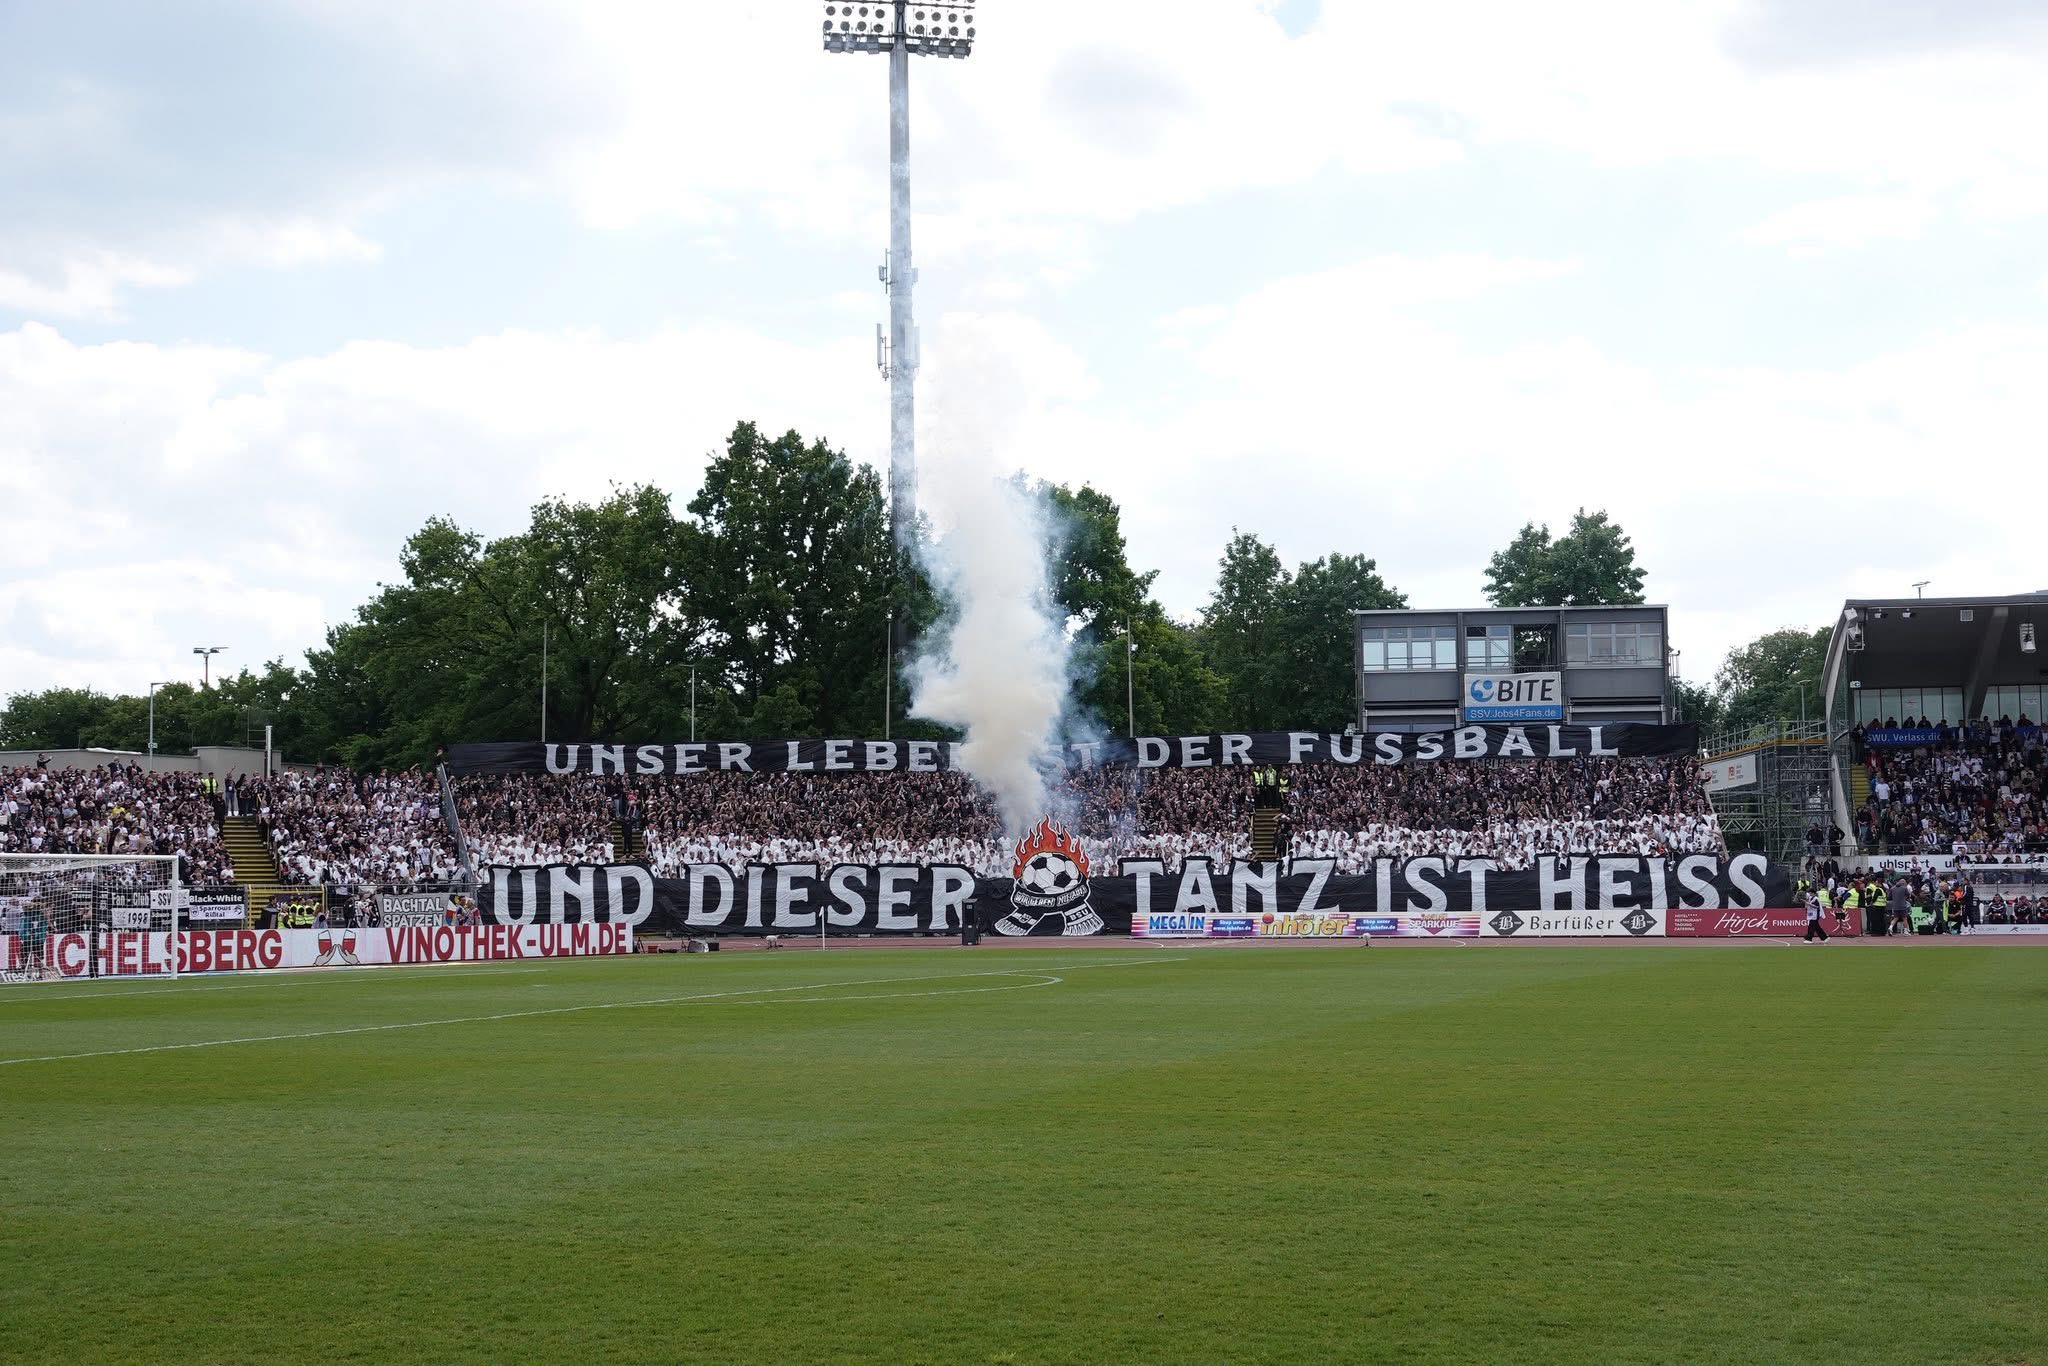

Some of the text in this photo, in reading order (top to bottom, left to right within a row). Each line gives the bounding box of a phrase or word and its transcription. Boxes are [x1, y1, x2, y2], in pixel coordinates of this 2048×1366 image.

[1497, 678, 1556, 702] BITE
[1470, 708, 1556, 719] SSV.Jobs4Fans.de
[1893, 732, 1926, 742] Verlass
[1928, 731, 1942, 742] dic
[544, 742, 754, 776] UNSER
[1135, 733, 1254, 768] DER
[1288, 724, 1619, 766] FUSSBALL
[189, 894, 243, 903] Black-White
[493, 853, 1769, 931] UND DIESER TANZ IST HEISS
[382, 897, 444, 913] BACHTAL
[128, 912, 149, 925] 1998
[382, 913, 444, 928] SPATZEN
[1149, 915, 1206, 930] MEGA IN
[1260, 913, 1350, 936] inhofer
[1408, 919, 1459, 929] SPARKAUF
[1530, 915, 1615, 930] Barfüßer
[1714, 912, 1769, 934] Hirsch
[386, 922, 627, 963] VINOTHEK-ULM.DE
